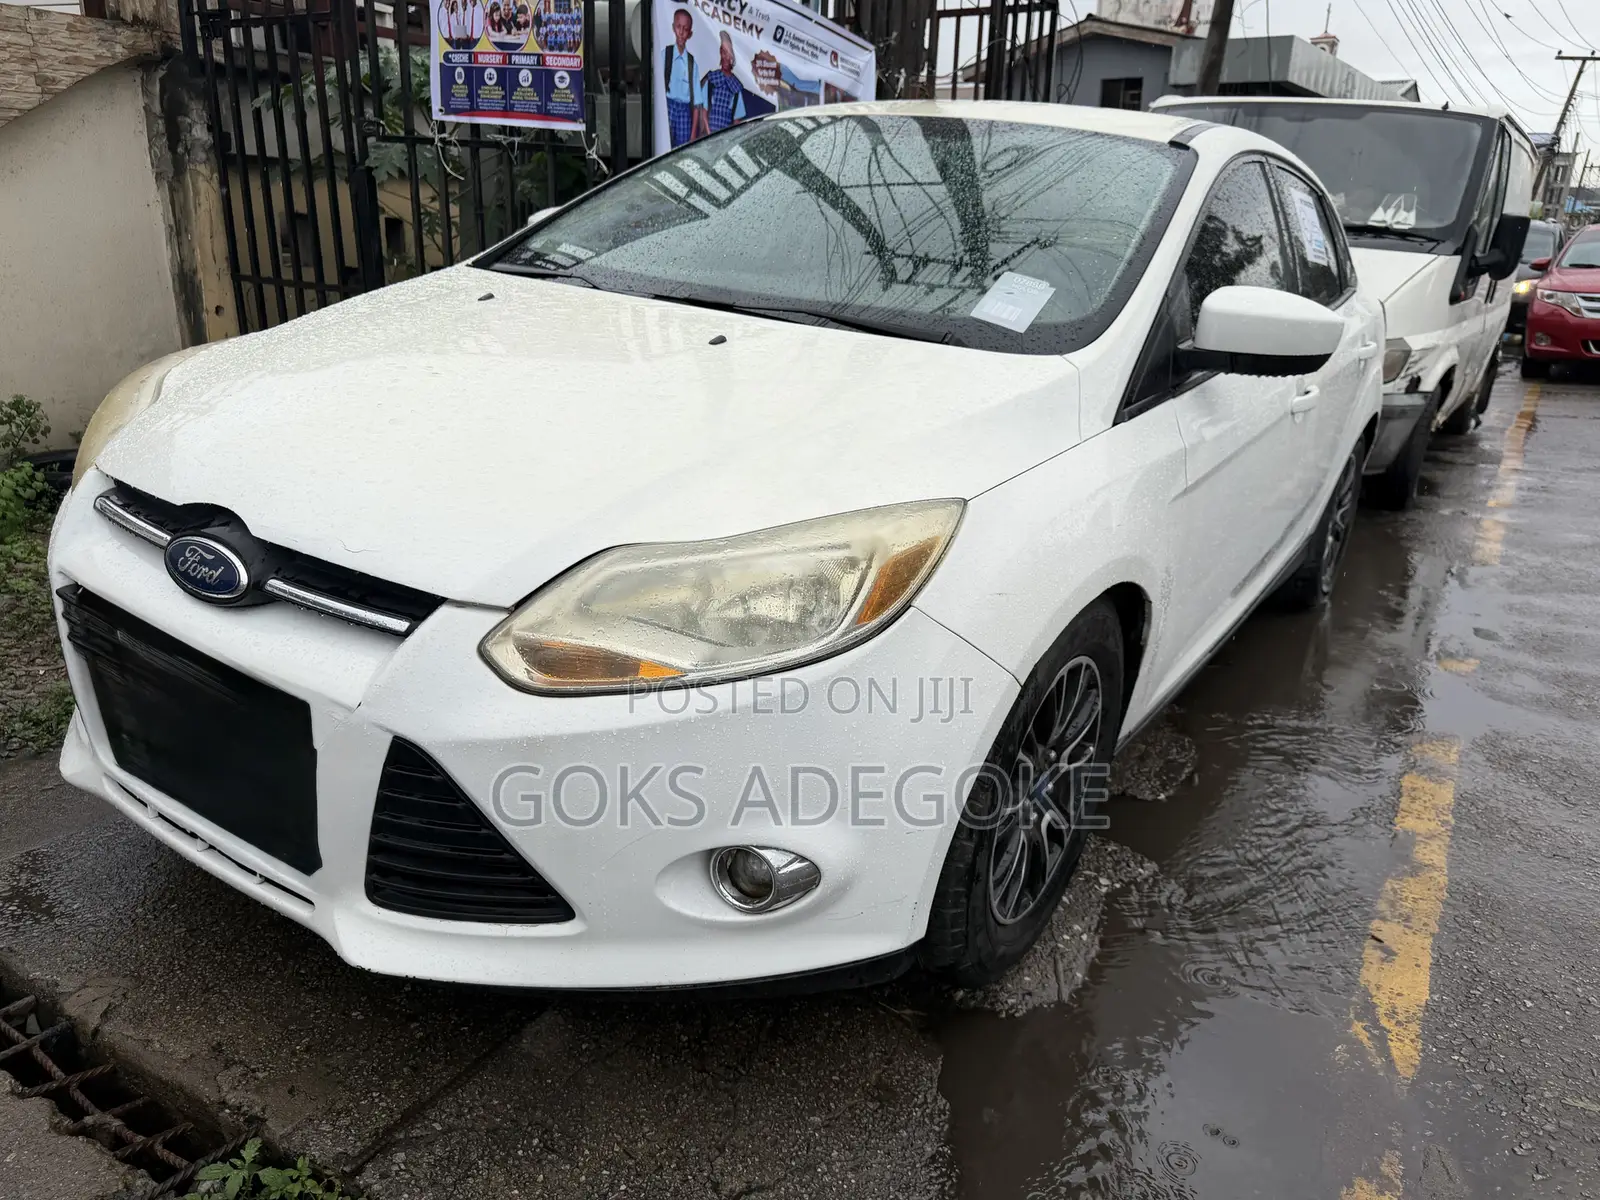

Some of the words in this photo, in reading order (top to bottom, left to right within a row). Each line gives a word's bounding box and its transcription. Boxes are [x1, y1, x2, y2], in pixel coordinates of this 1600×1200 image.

[755, 8, 771, 23] Truth
[478, 54, 503, 64] NURSERY
[511, 54, 538, 65] PRIMARY
[545, 56, 581, 67] SECONDARY
[178, 545, 225, 586] Ford
